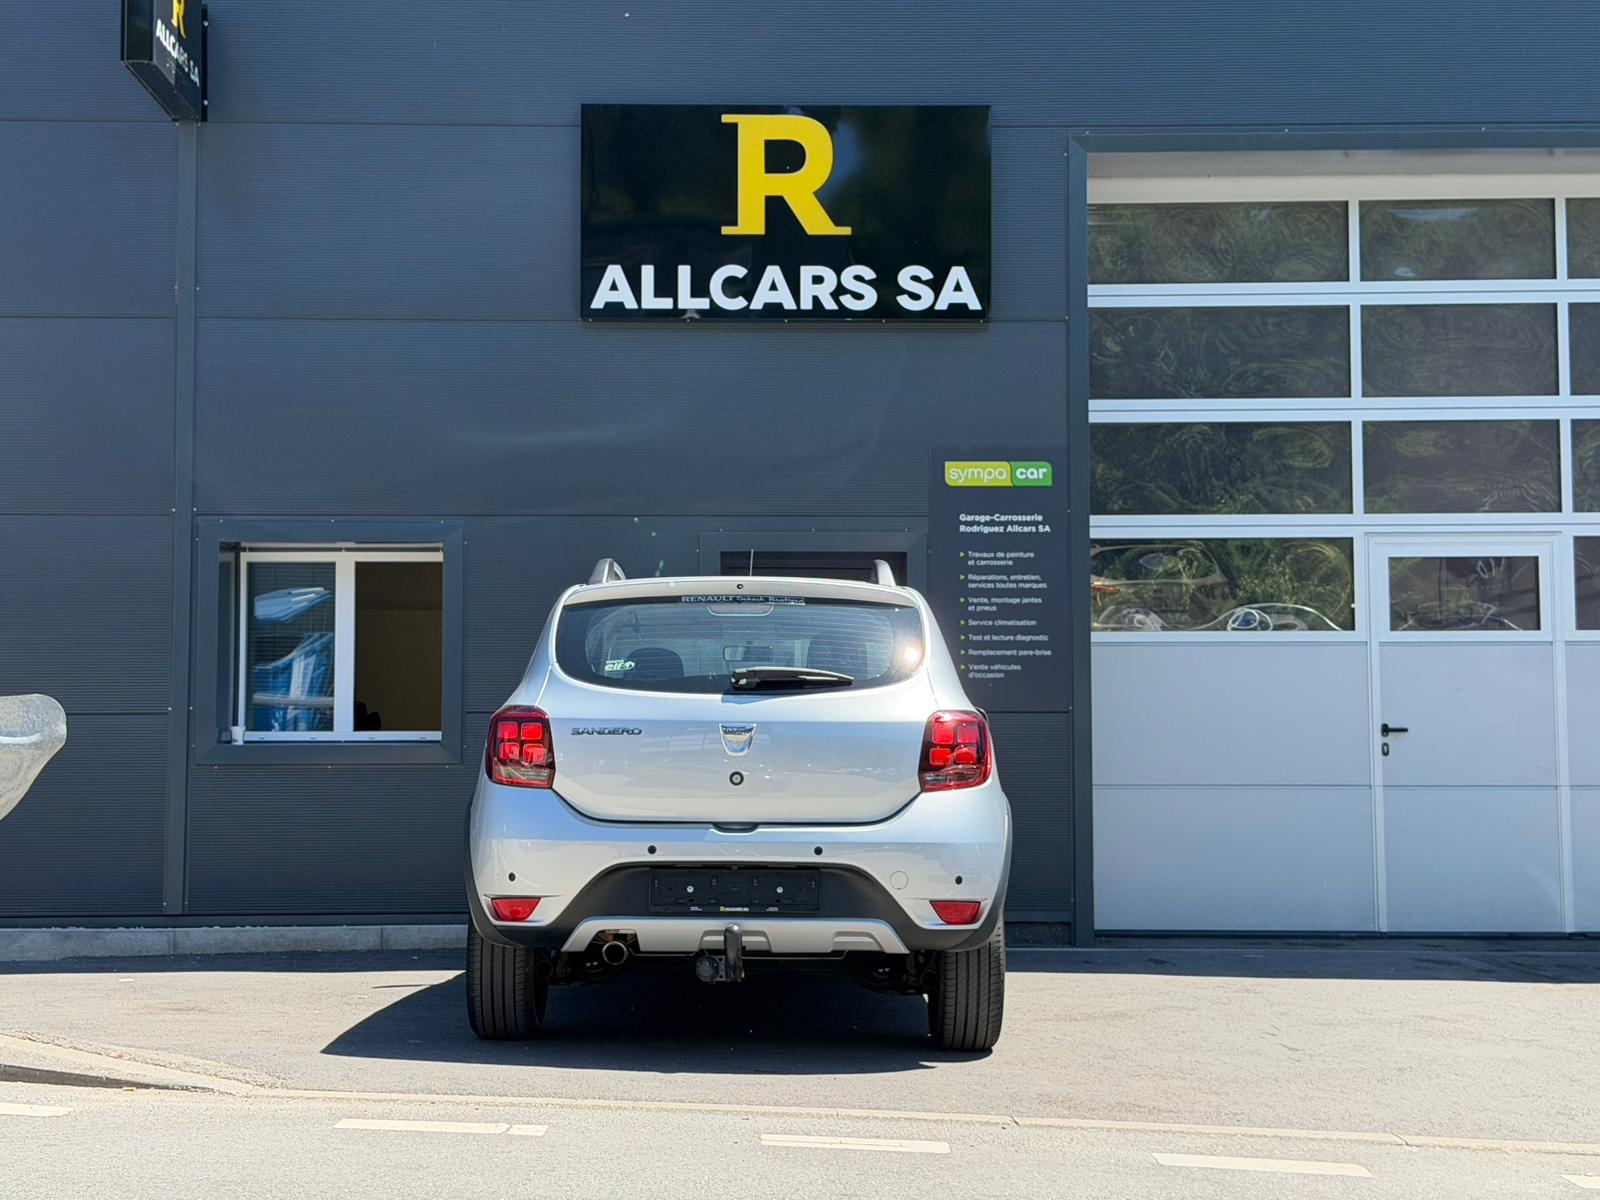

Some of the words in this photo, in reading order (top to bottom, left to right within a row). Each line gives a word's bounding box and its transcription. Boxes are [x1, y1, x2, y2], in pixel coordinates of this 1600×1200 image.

[721, 114, 852, 235] R
[590, 264, 878, 311] ALLCARS
[896, 265, 982, 311] SA
[949, 468, 1006, 482] sympa
[1016, 468, 1047, 479] car
[960, 514, 1043, 522] Garage-Carrosserie
[960, 525, 1003, 534] Rodriguez
[571, 728, 642, 736] SANDERO
